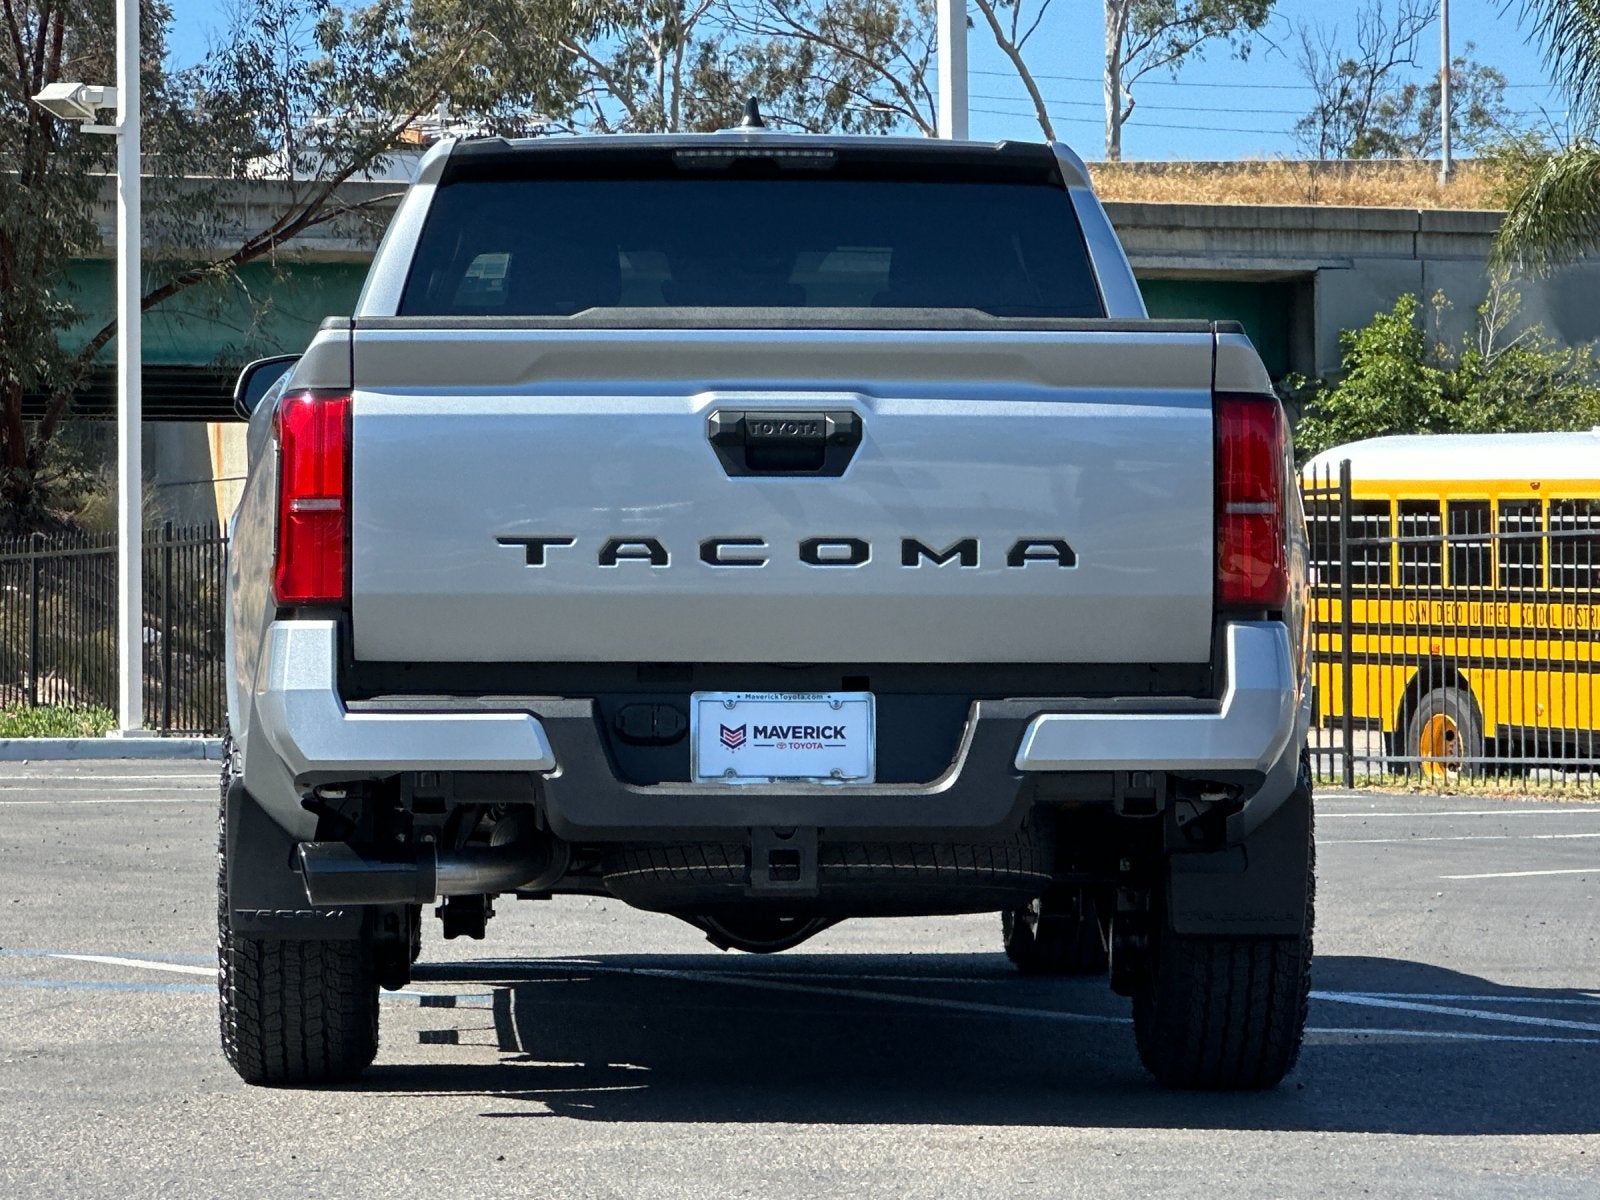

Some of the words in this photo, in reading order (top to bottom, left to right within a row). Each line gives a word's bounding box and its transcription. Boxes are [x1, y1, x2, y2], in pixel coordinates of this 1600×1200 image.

[752, 422, 823, 436] TOYOTA
[495, 536, 1078, 568] TACOMA
[753, 725, 846, 740] MAVERICK
[788, 742, 824, 750] TOYOTA
